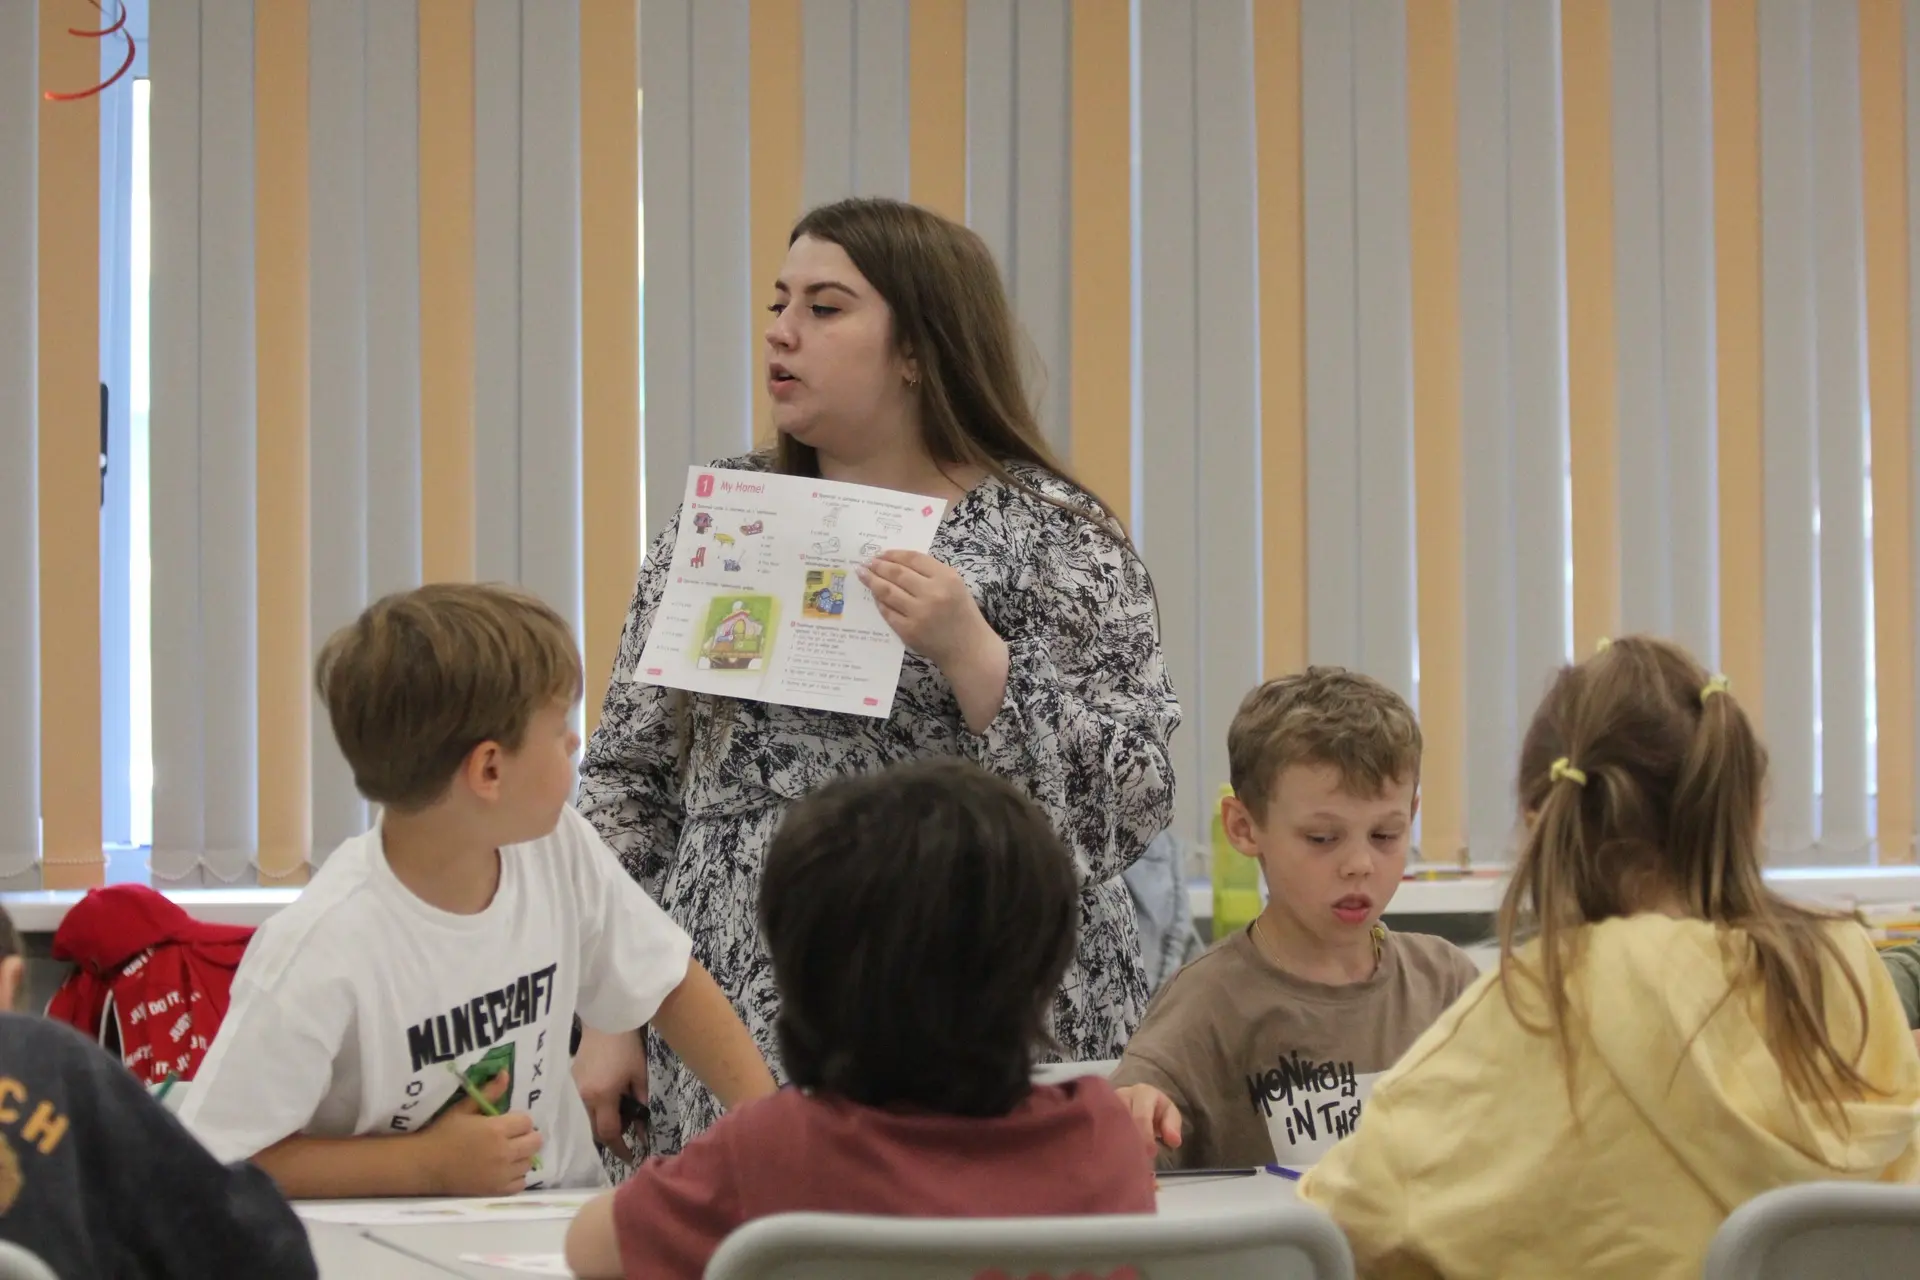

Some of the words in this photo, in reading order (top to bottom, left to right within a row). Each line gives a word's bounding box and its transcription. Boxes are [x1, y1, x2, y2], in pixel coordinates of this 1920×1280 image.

[720, 481, 733, 494] My
[735, 482, 765, 494] Home!
[407, 962, 557, 1073] MINECRAFT
